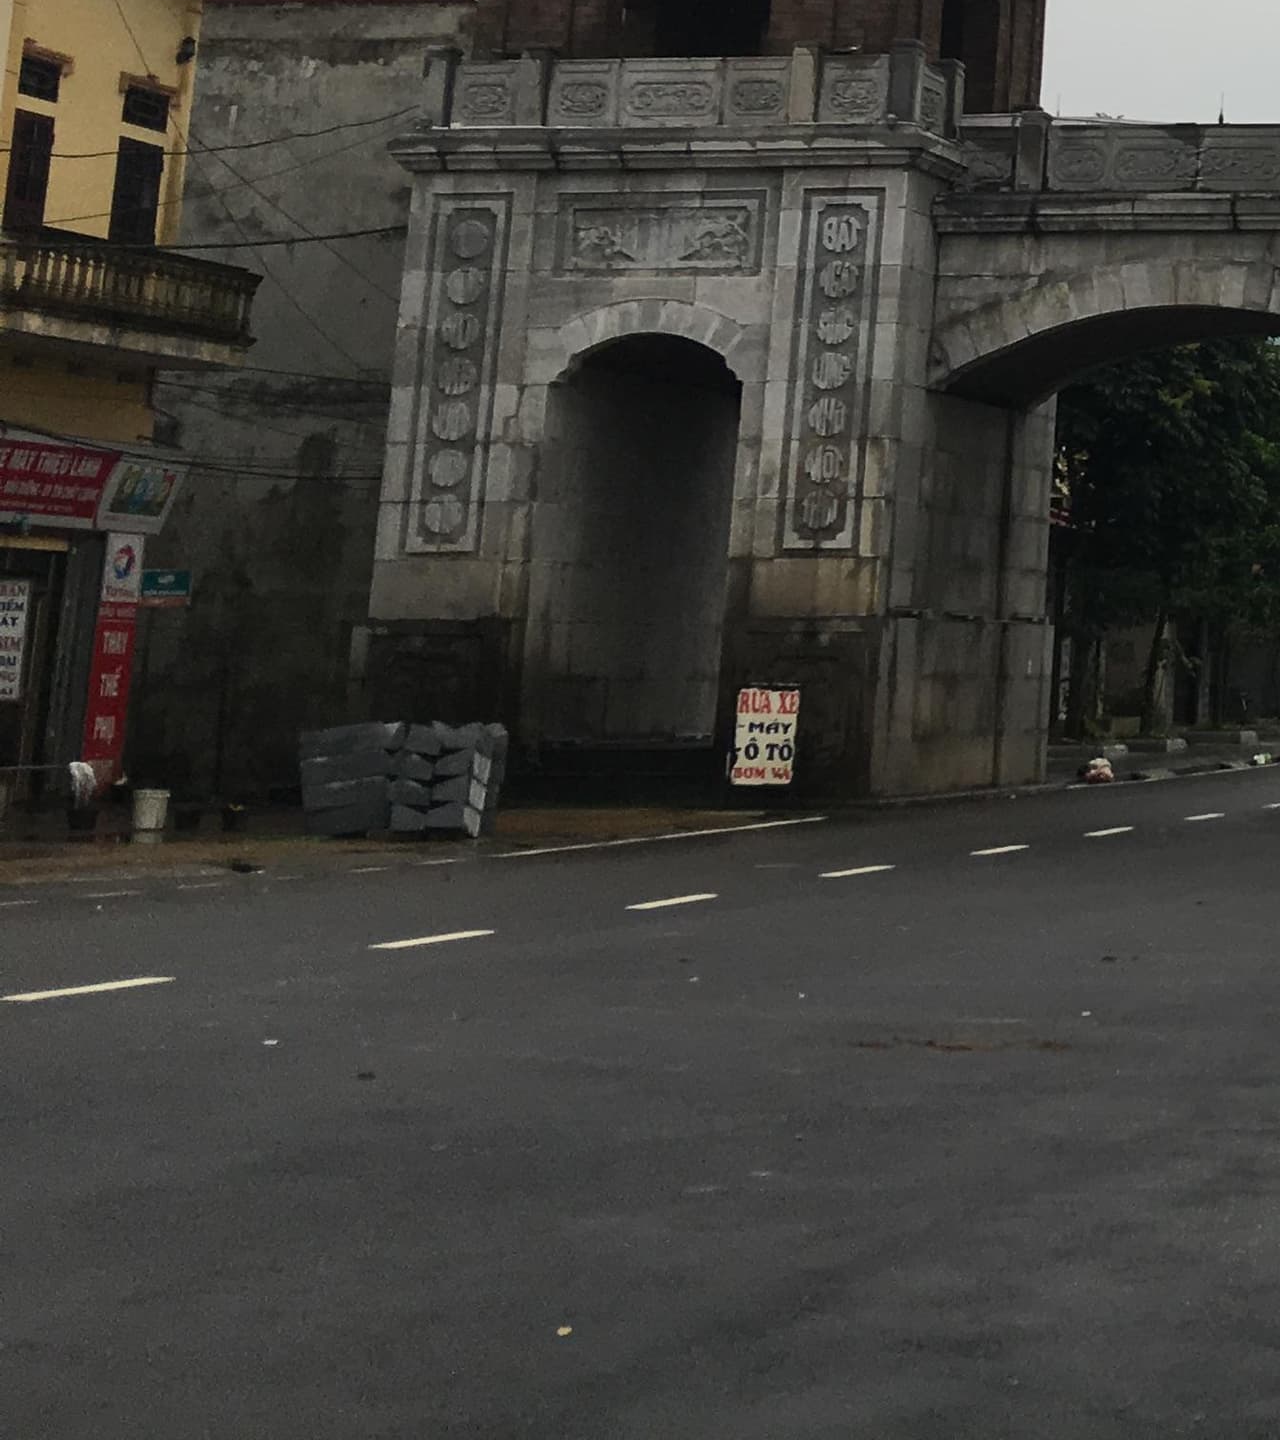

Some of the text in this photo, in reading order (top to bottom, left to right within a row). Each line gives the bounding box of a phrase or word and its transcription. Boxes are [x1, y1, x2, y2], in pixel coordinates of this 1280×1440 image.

[103, 631, 128, 655] THAY
[100, 665, 122, 697] THẾ
[778, 691, 799, 714] XE
[748, 718, 792, 735] MÁY
[744, 737, 792, 761] Ô TÔ
